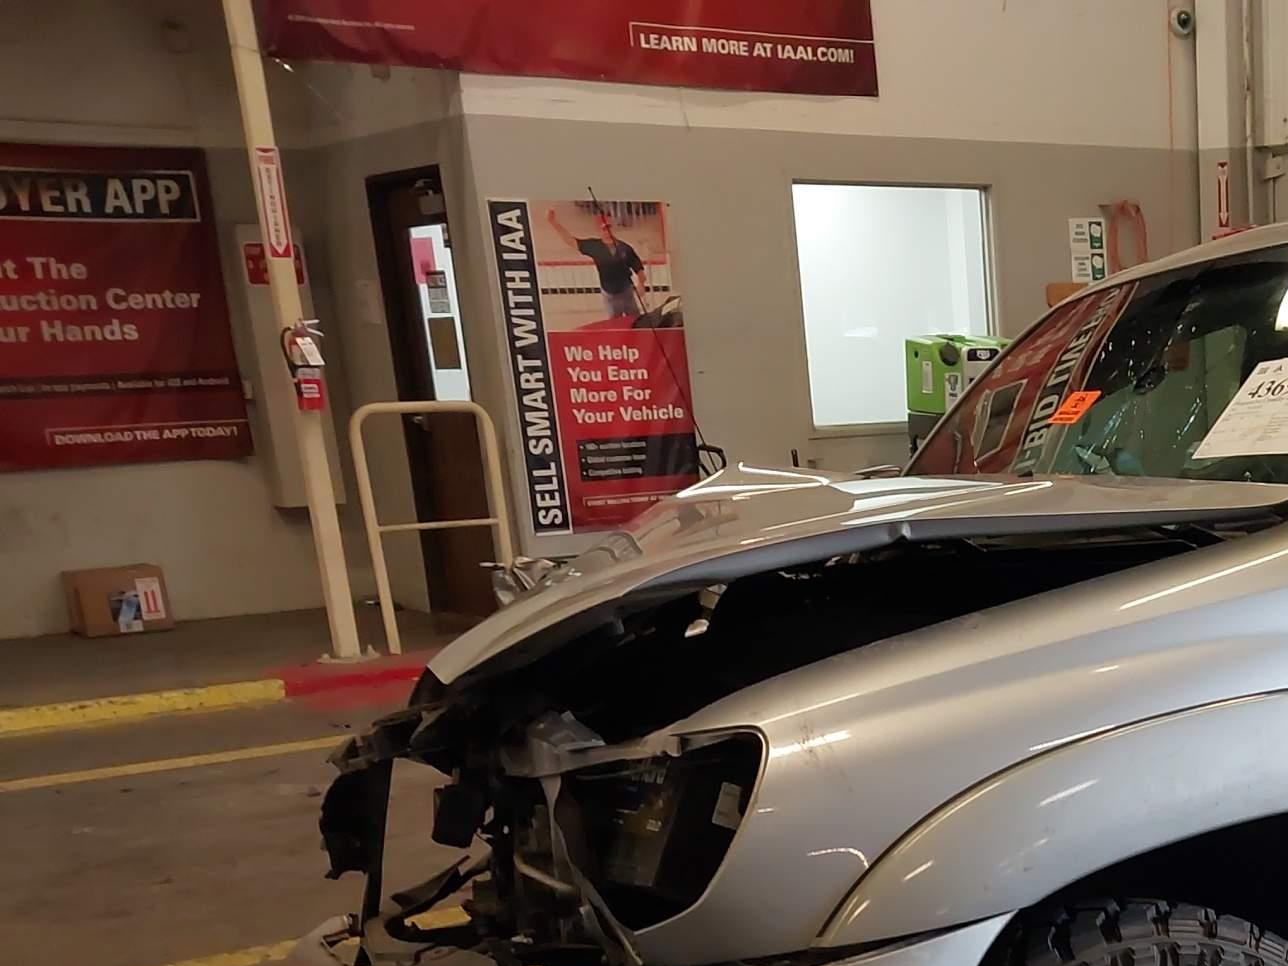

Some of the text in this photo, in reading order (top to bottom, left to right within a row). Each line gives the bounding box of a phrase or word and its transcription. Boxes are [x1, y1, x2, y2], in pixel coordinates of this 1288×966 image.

[639, 33, 855, 63] LEARN MORE AT IAAI.COM!
[0, 177, 181, 214] YER APP
[26, 257, 87, 279] The
[105, 288, 200, 310] Center
[41, 318, 139, 342] Hands
[564, 344, 640, 363] We Help
[497, 208, 563, 525] SELL SMART WITH IAA
[567, 365, 648, 382] You Earn
[570, 386, 651, 403] More For
[572, 404, 684, 424] Your Vehicle
[54, 426, 238, 446] DOWNLOAD THE APP TODAY!
